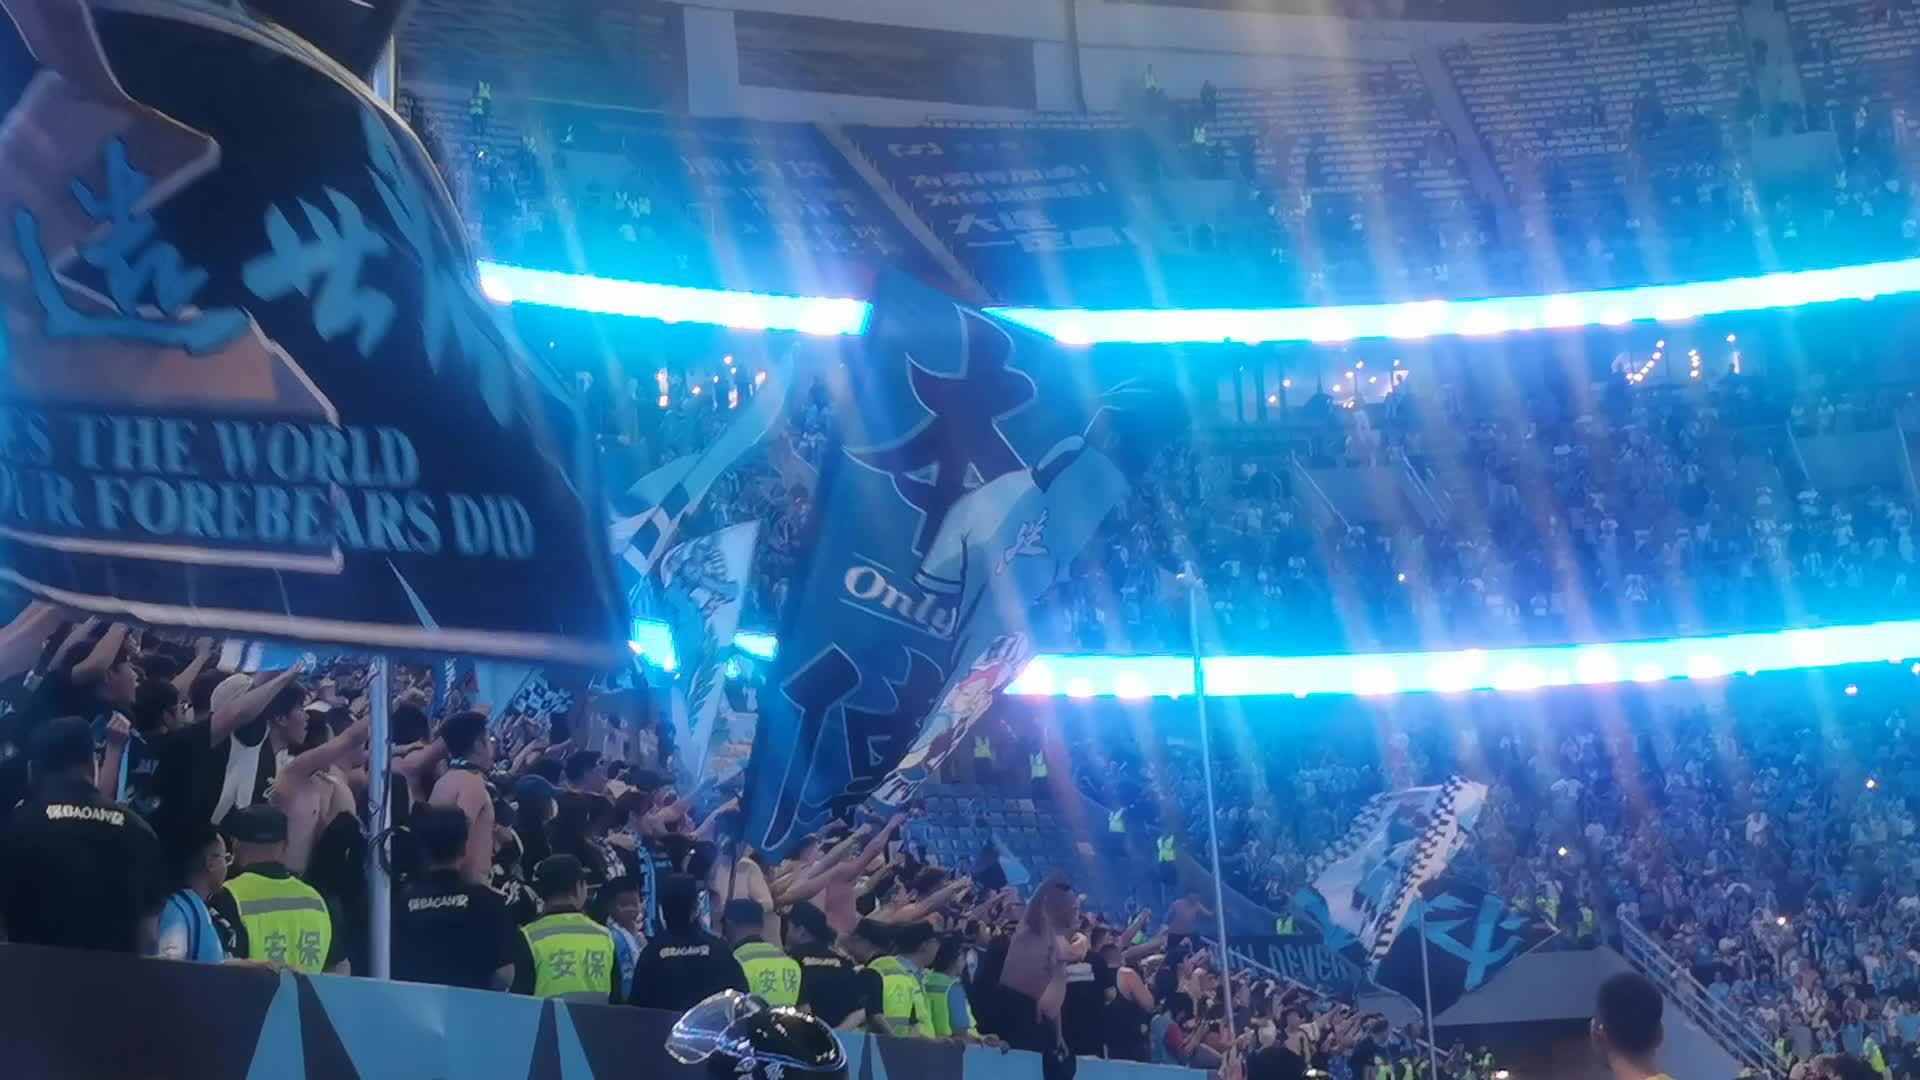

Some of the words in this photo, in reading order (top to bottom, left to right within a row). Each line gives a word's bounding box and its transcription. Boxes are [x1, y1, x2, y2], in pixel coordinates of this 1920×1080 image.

[70, 413, 198, 475] THE
[211, 418, 421, 488] WORLD
[92, 475, 441, 556] FOREBEARS
[447, 490, 537, 561] DID
[843, 565, 958, 641] Only
[262, 927, 321, 968] 安保
[549, 948, 607, 980] 安保
[758, 967, 799, 994] 安保
